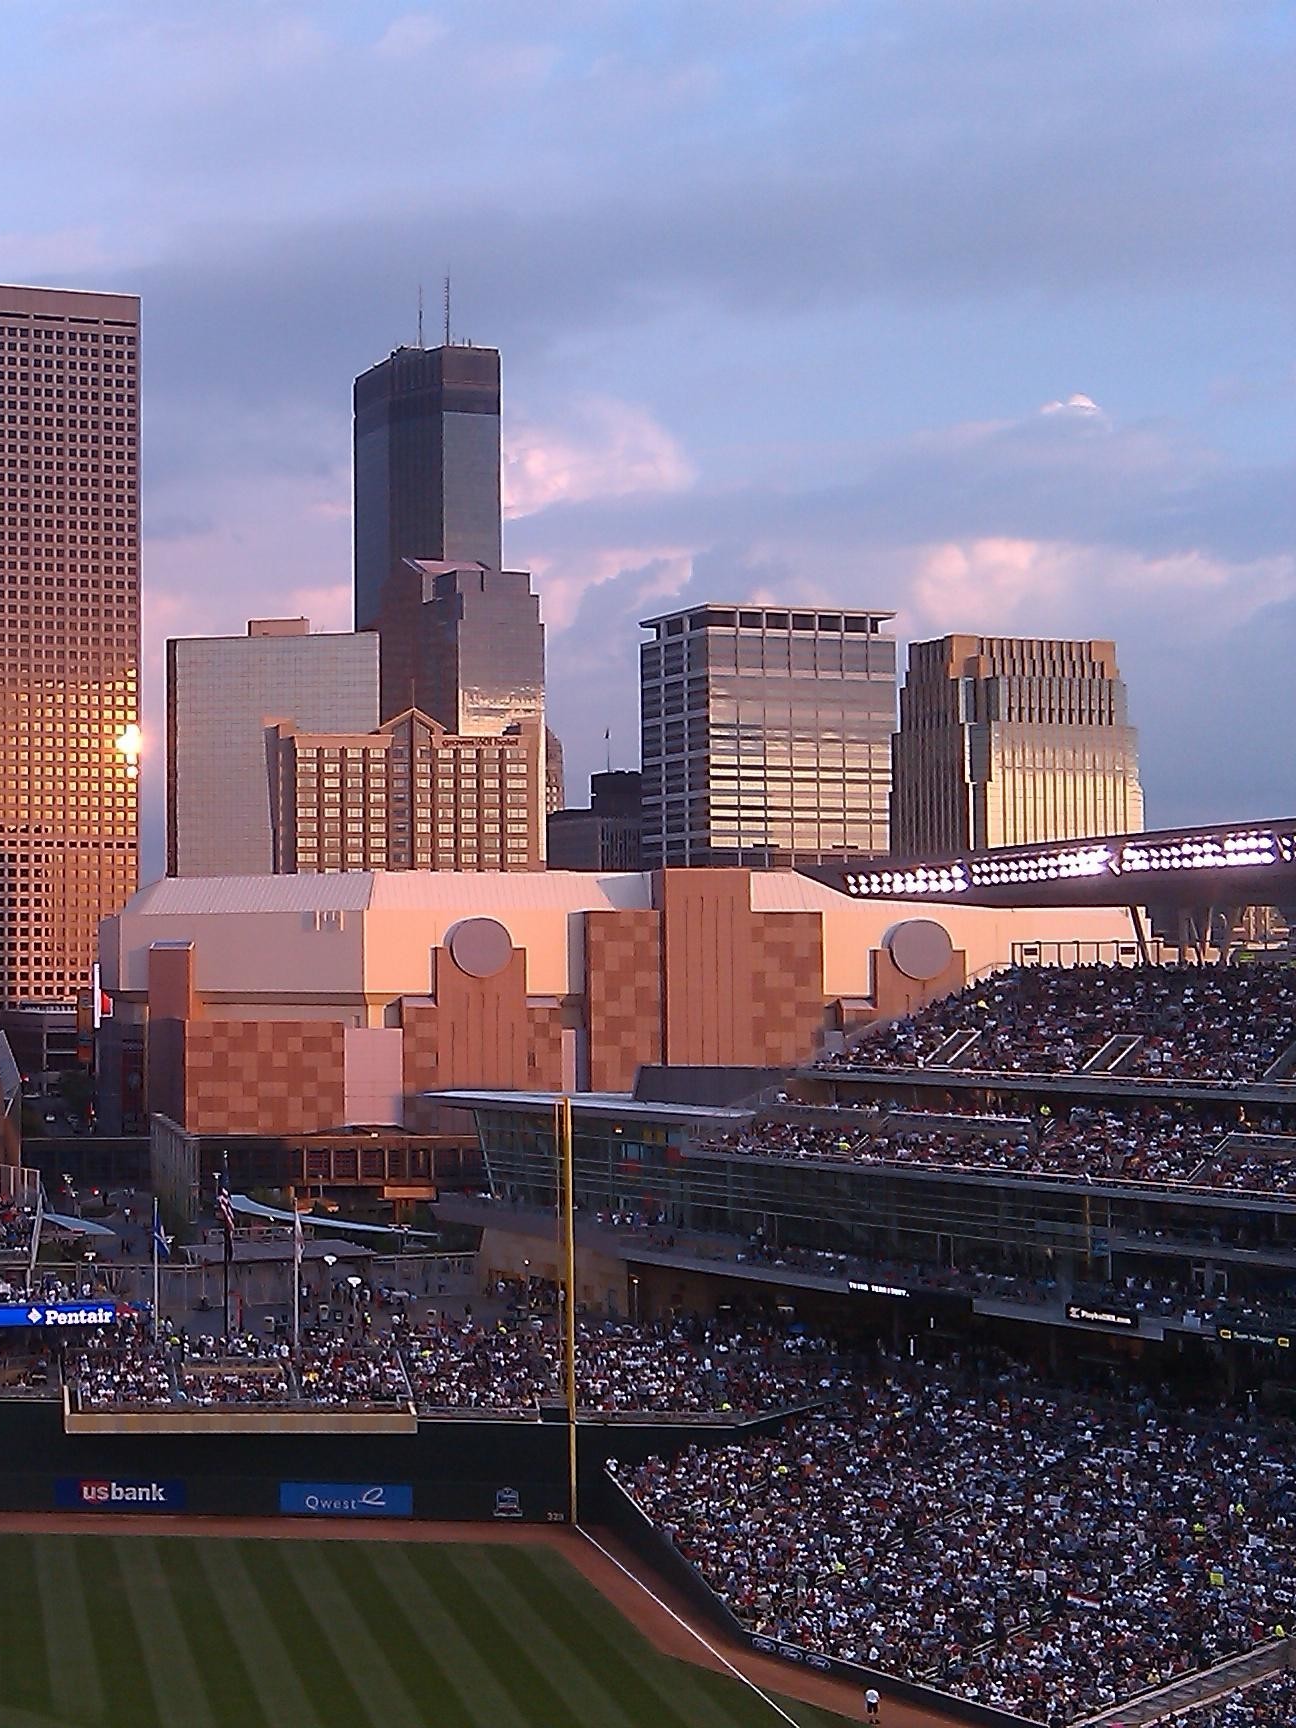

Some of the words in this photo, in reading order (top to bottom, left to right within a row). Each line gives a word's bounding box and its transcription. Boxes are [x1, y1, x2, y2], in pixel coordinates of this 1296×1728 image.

[45, 1307, 113, 1325] Pentair
[82, 1481, 166, 1502] usbank
[304, 1495, 357, 1511] Qwest
